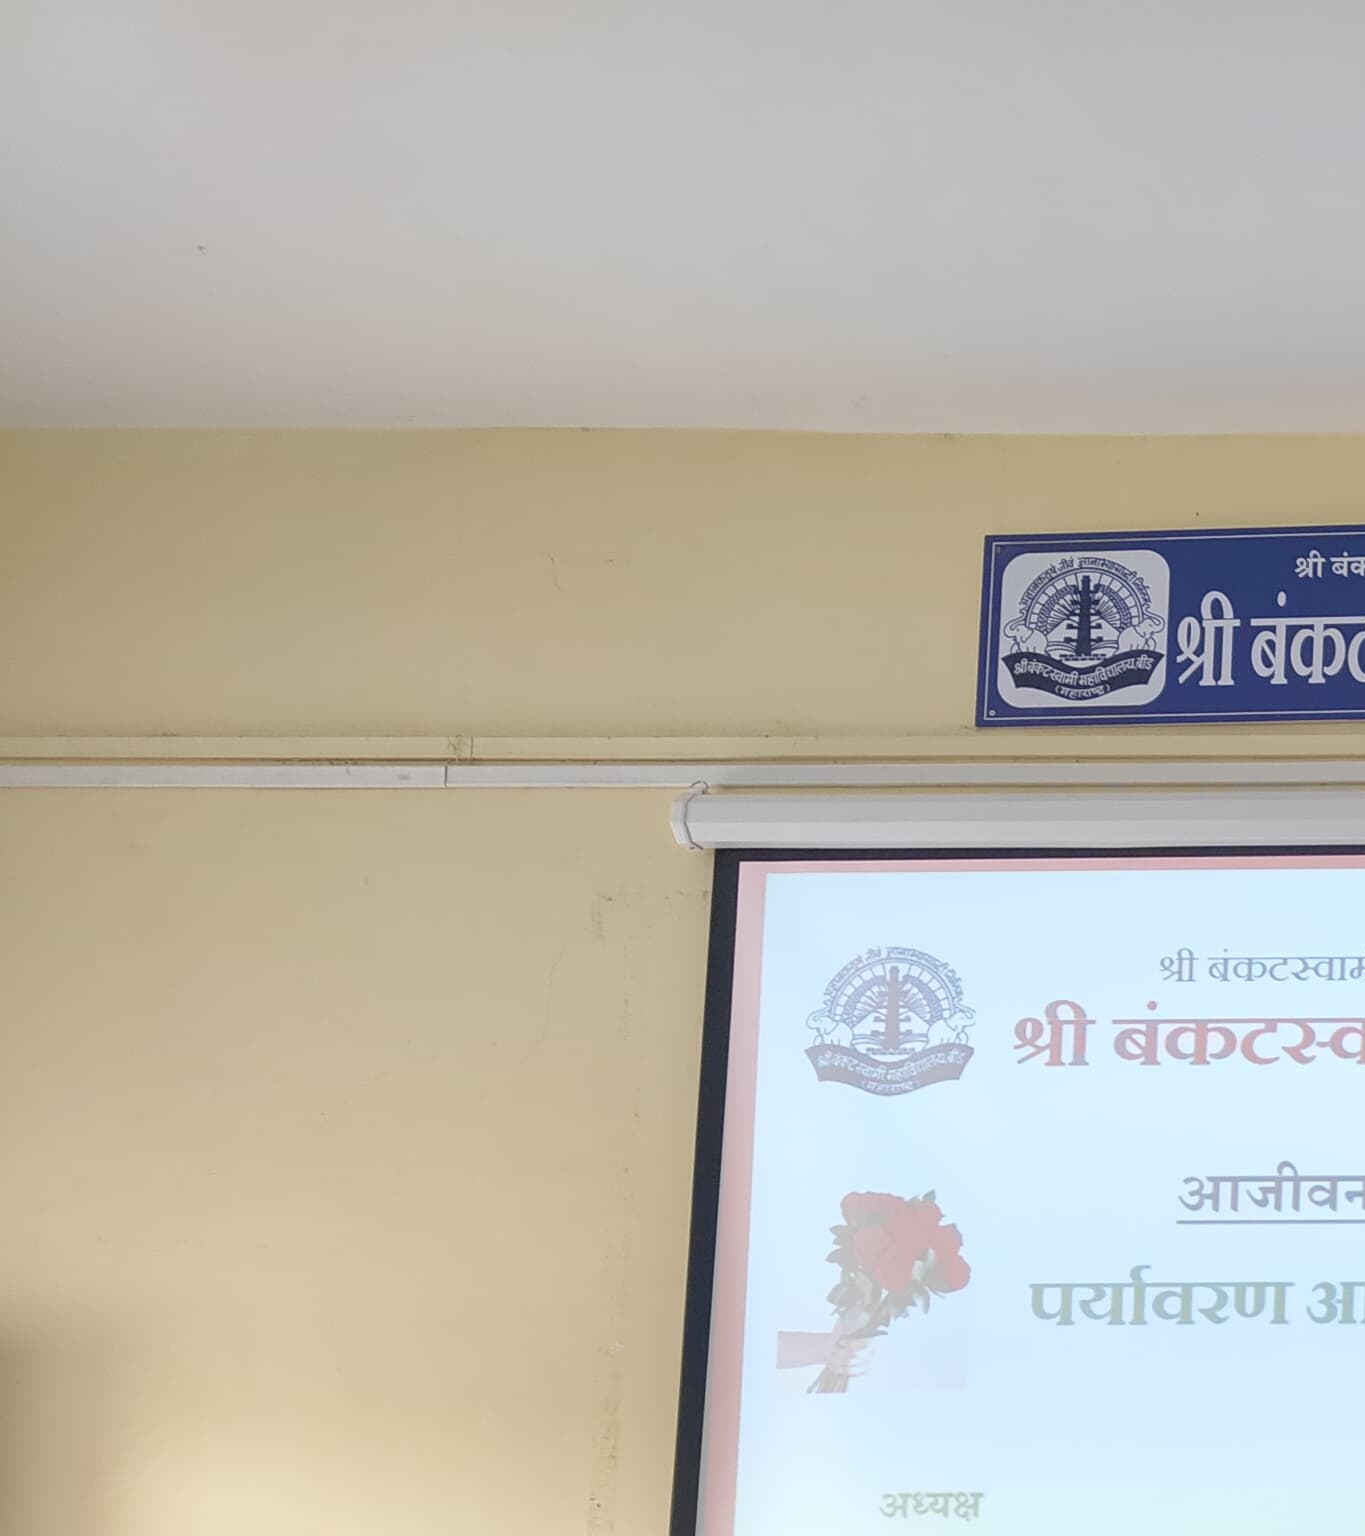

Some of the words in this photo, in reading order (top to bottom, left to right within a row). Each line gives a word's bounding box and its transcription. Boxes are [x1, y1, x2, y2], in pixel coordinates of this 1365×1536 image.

[1294, 549, 1327, 578] श्री
[1176, 590, 1241, 687] श्री
[1159, 947, 1200, 983] श्री
[1014, 998, 1096, 1067] श्री
[1029, 1265, 1295, 1326] पर्यावरण
[880, 1492, 984, 1521] अध्यक्ष
